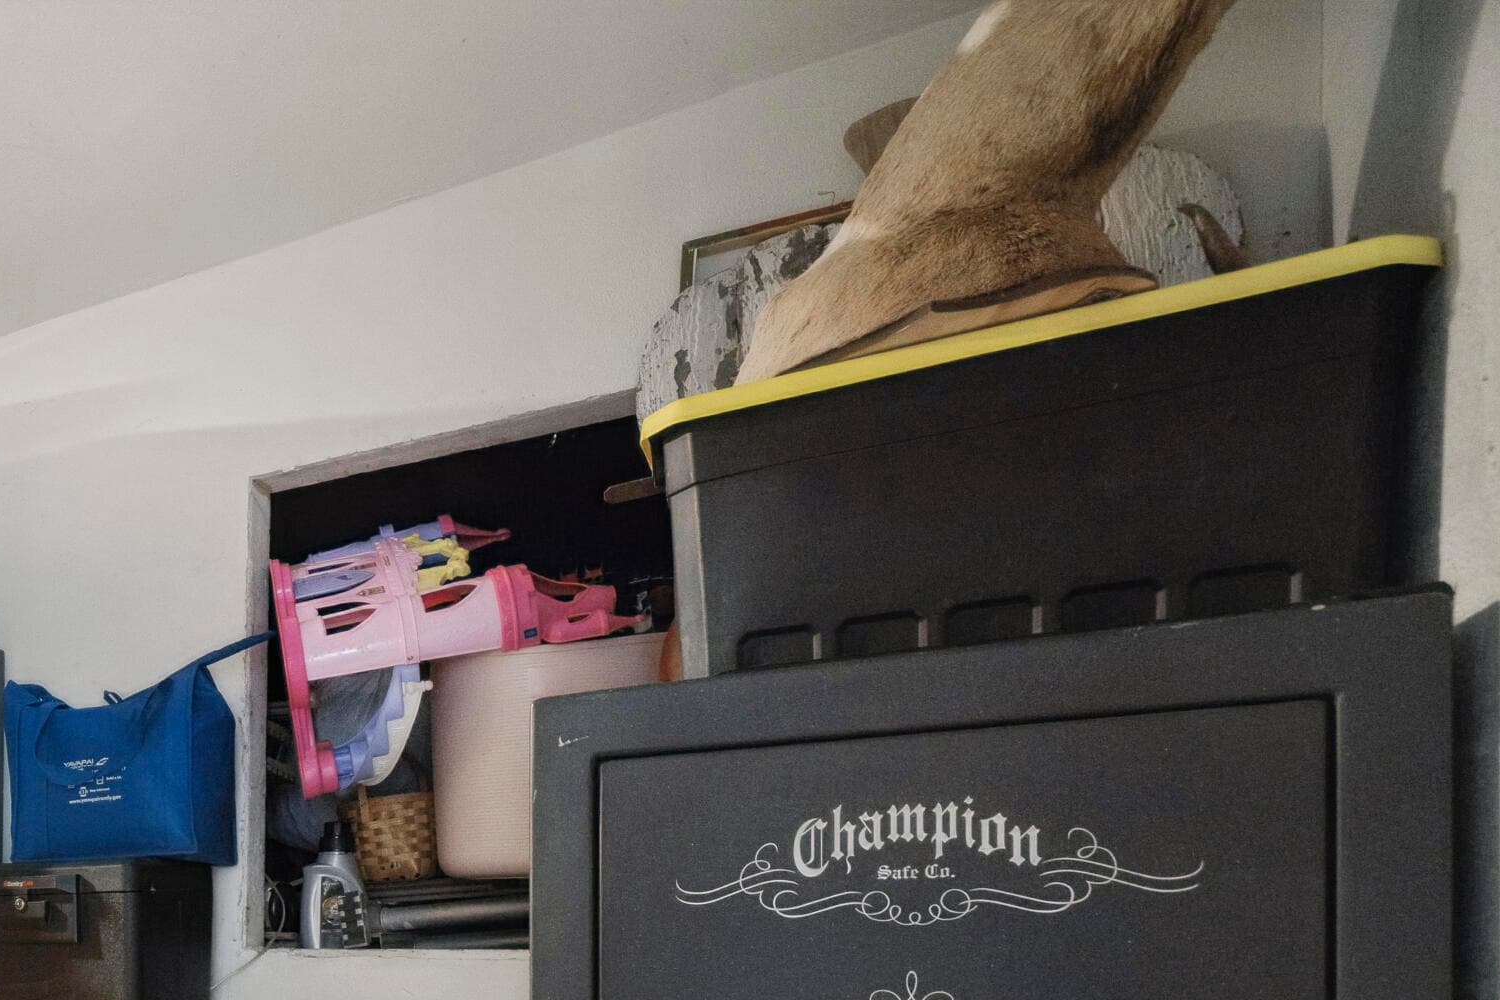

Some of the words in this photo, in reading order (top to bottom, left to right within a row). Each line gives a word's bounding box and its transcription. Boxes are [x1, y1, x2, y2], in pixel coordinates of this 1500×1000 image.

[792, 795, 1043, 878] Champion
[876, 864, 920, 881] Safe
[924, 863, 957, 880] Co.
